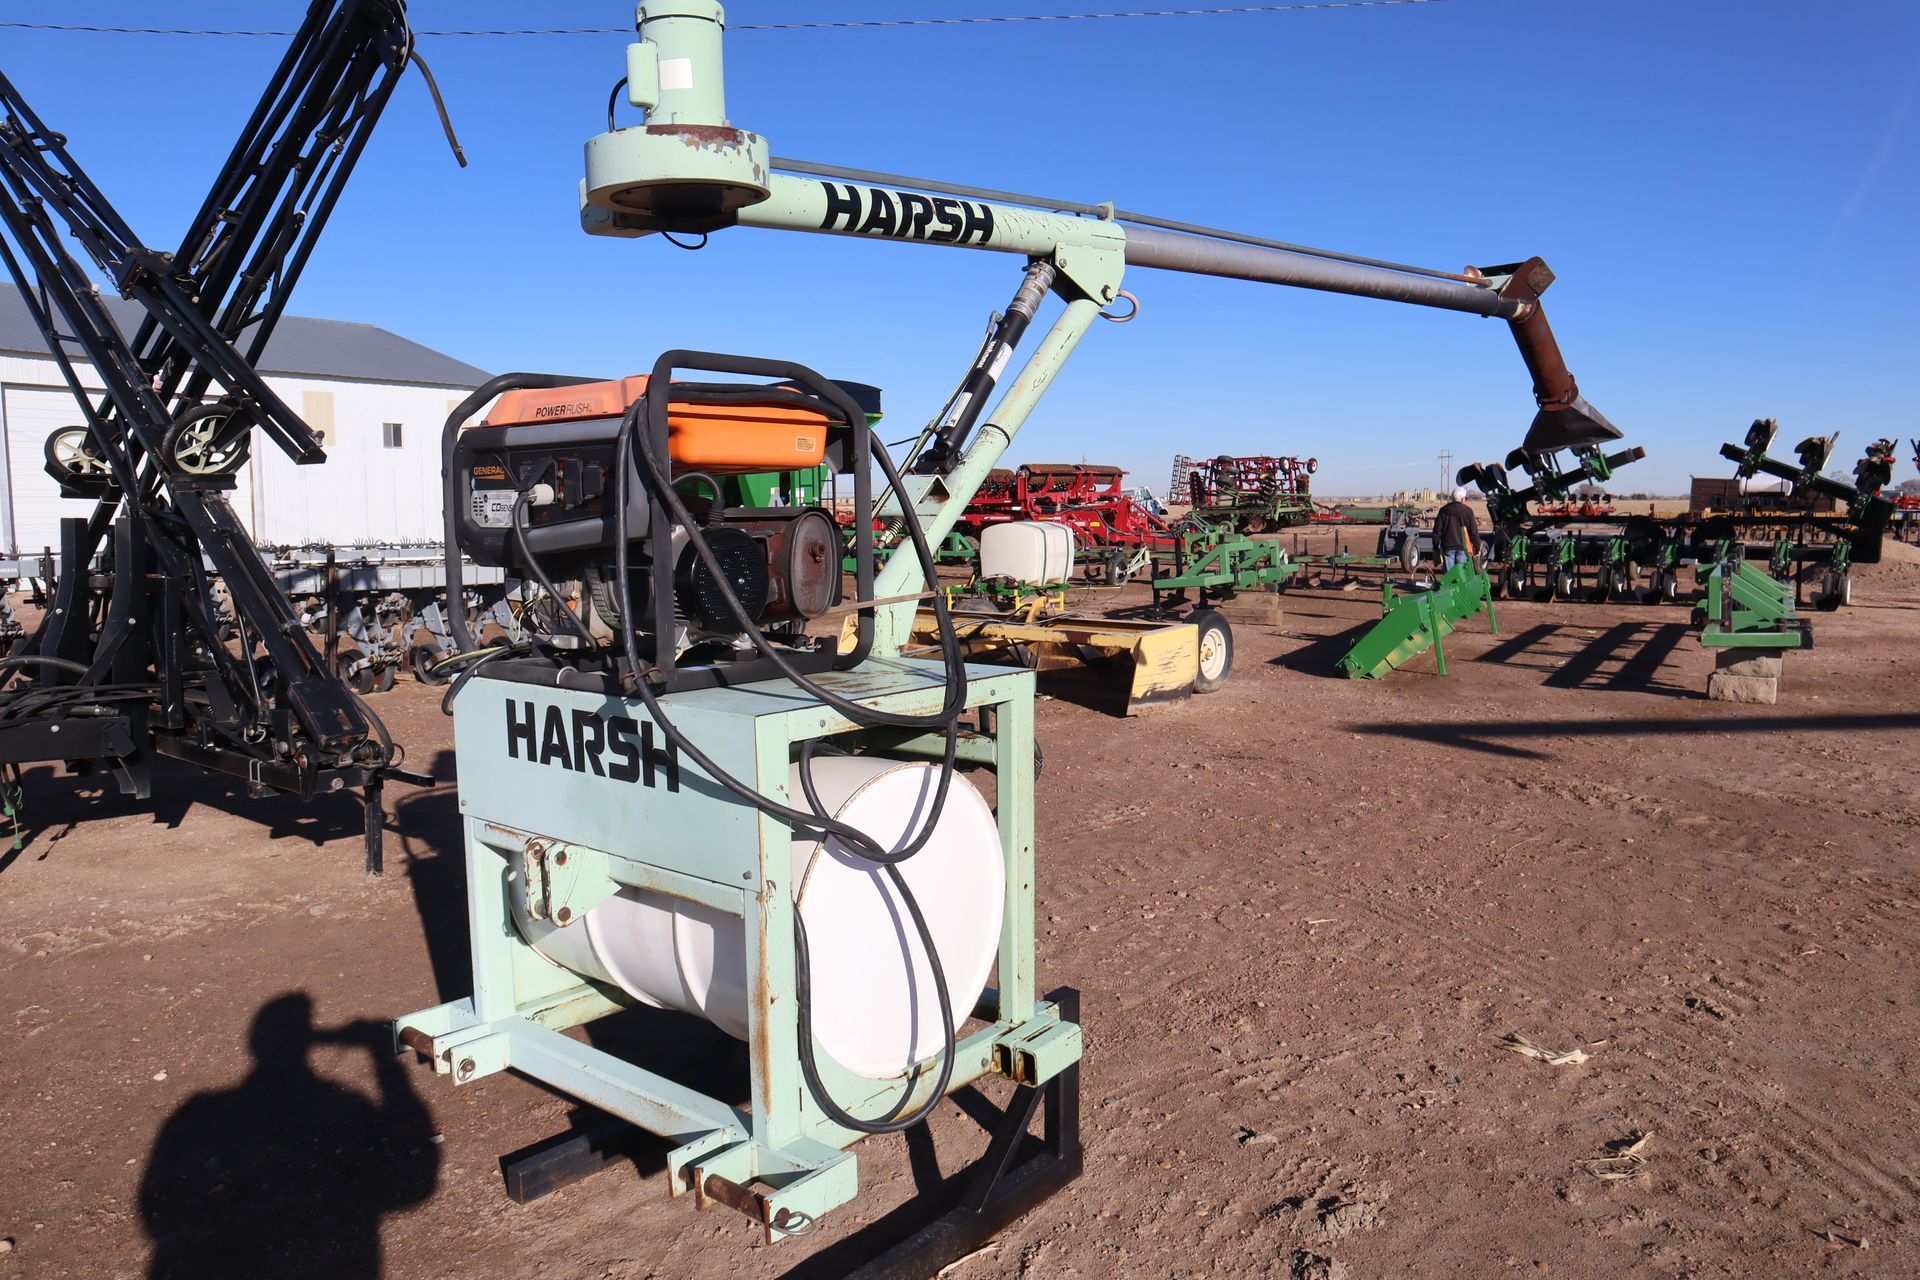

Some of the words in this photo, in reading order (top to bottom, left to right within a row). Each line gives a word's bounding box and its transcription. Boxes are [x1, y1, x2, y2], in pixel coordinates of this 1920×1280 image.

[820, 181, 995, 247] HARSH
[535, 402, 590, 418] POWERRUSH
[505, 698, 680, 794] HARSH
